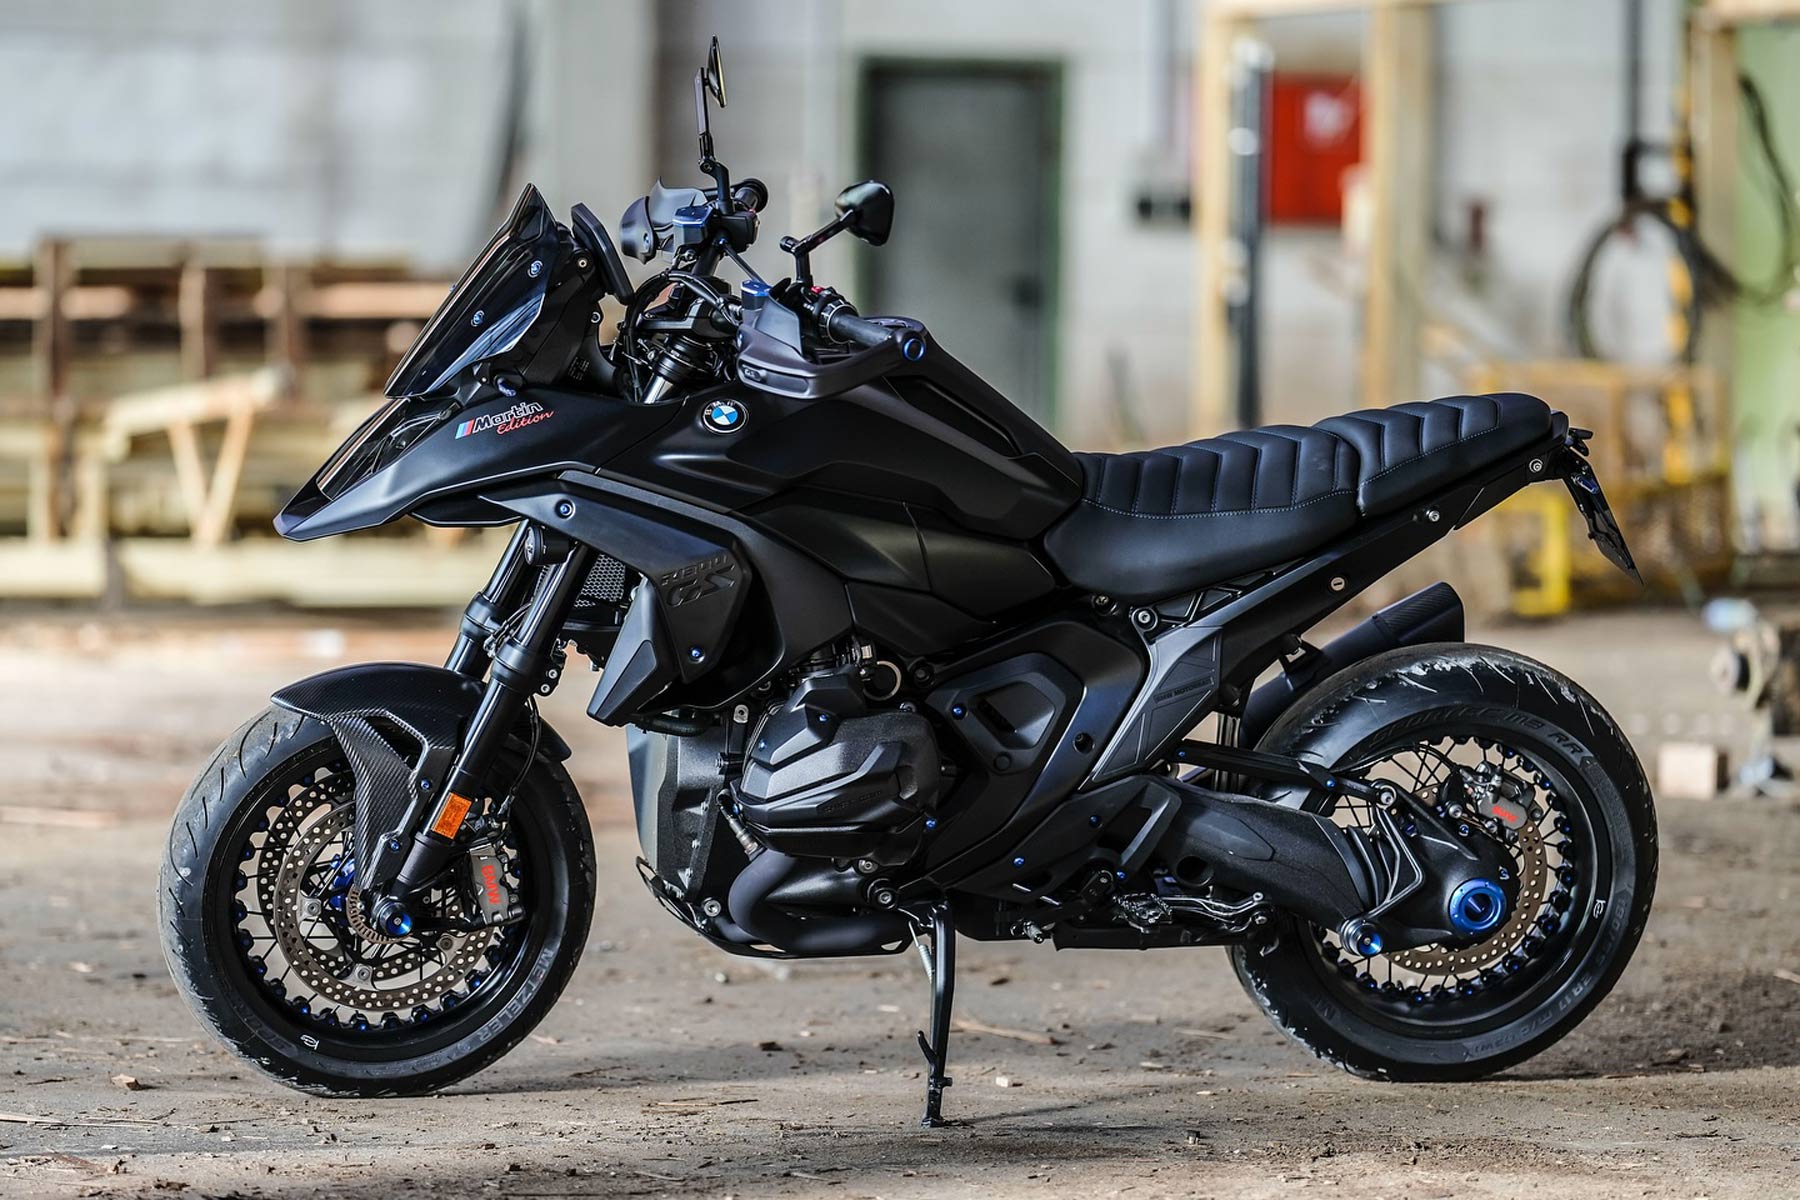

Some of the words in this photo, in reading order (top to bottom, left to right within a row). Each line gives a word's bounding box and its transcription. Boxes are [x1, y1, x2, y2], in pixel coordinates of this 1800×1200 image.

[472, 401, 544, 434] Martin
[496, 411, 554, 435] Edition
[667, 564, 736, 607] GS
[1547, 731, 1584, 755] RR
[481, 864, 501, 905] BMW
[477, 948, 554, 1042] METZELER
